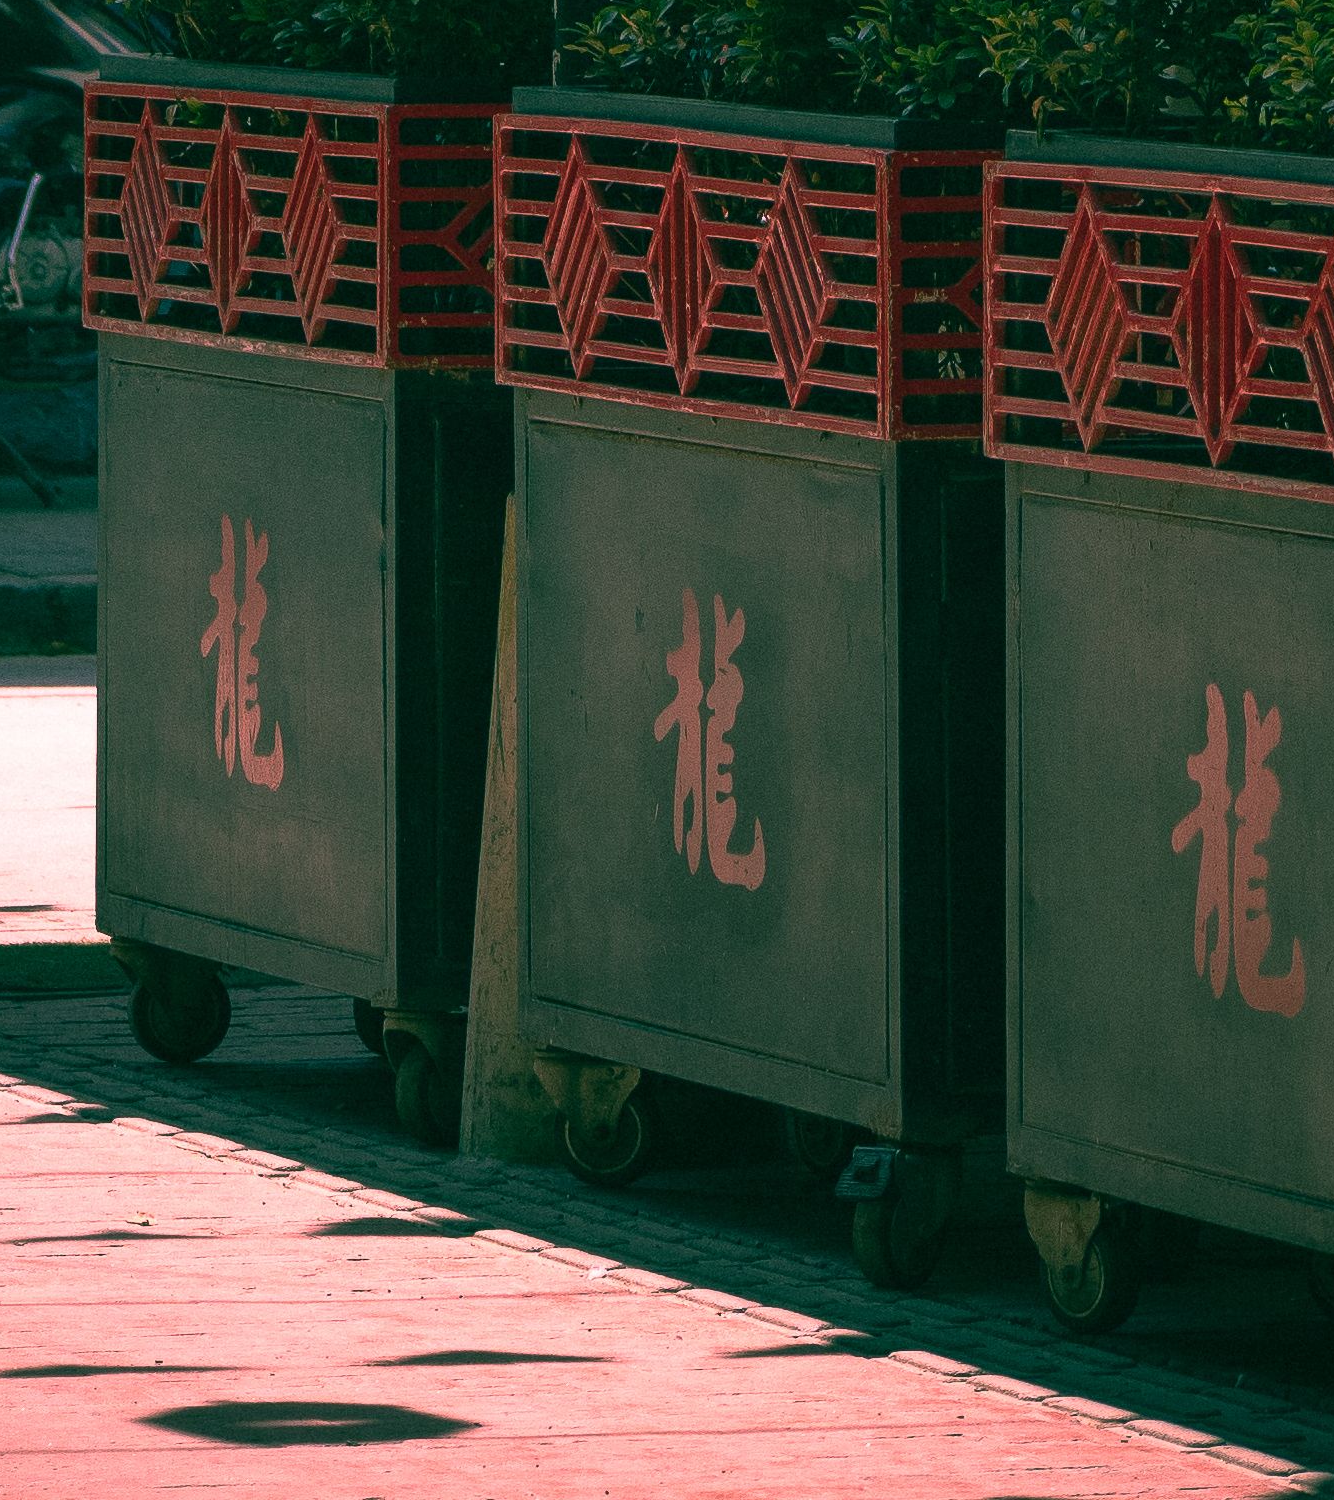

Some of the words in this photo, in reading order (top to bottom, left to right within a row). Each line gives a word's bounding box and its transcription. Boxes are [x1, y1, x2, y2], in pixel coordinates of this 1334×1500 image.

[199, 512, 285, 791] 龍
[653, 587, 766, 892] 龍
[1171, 683, 1306, 1018] 龍
